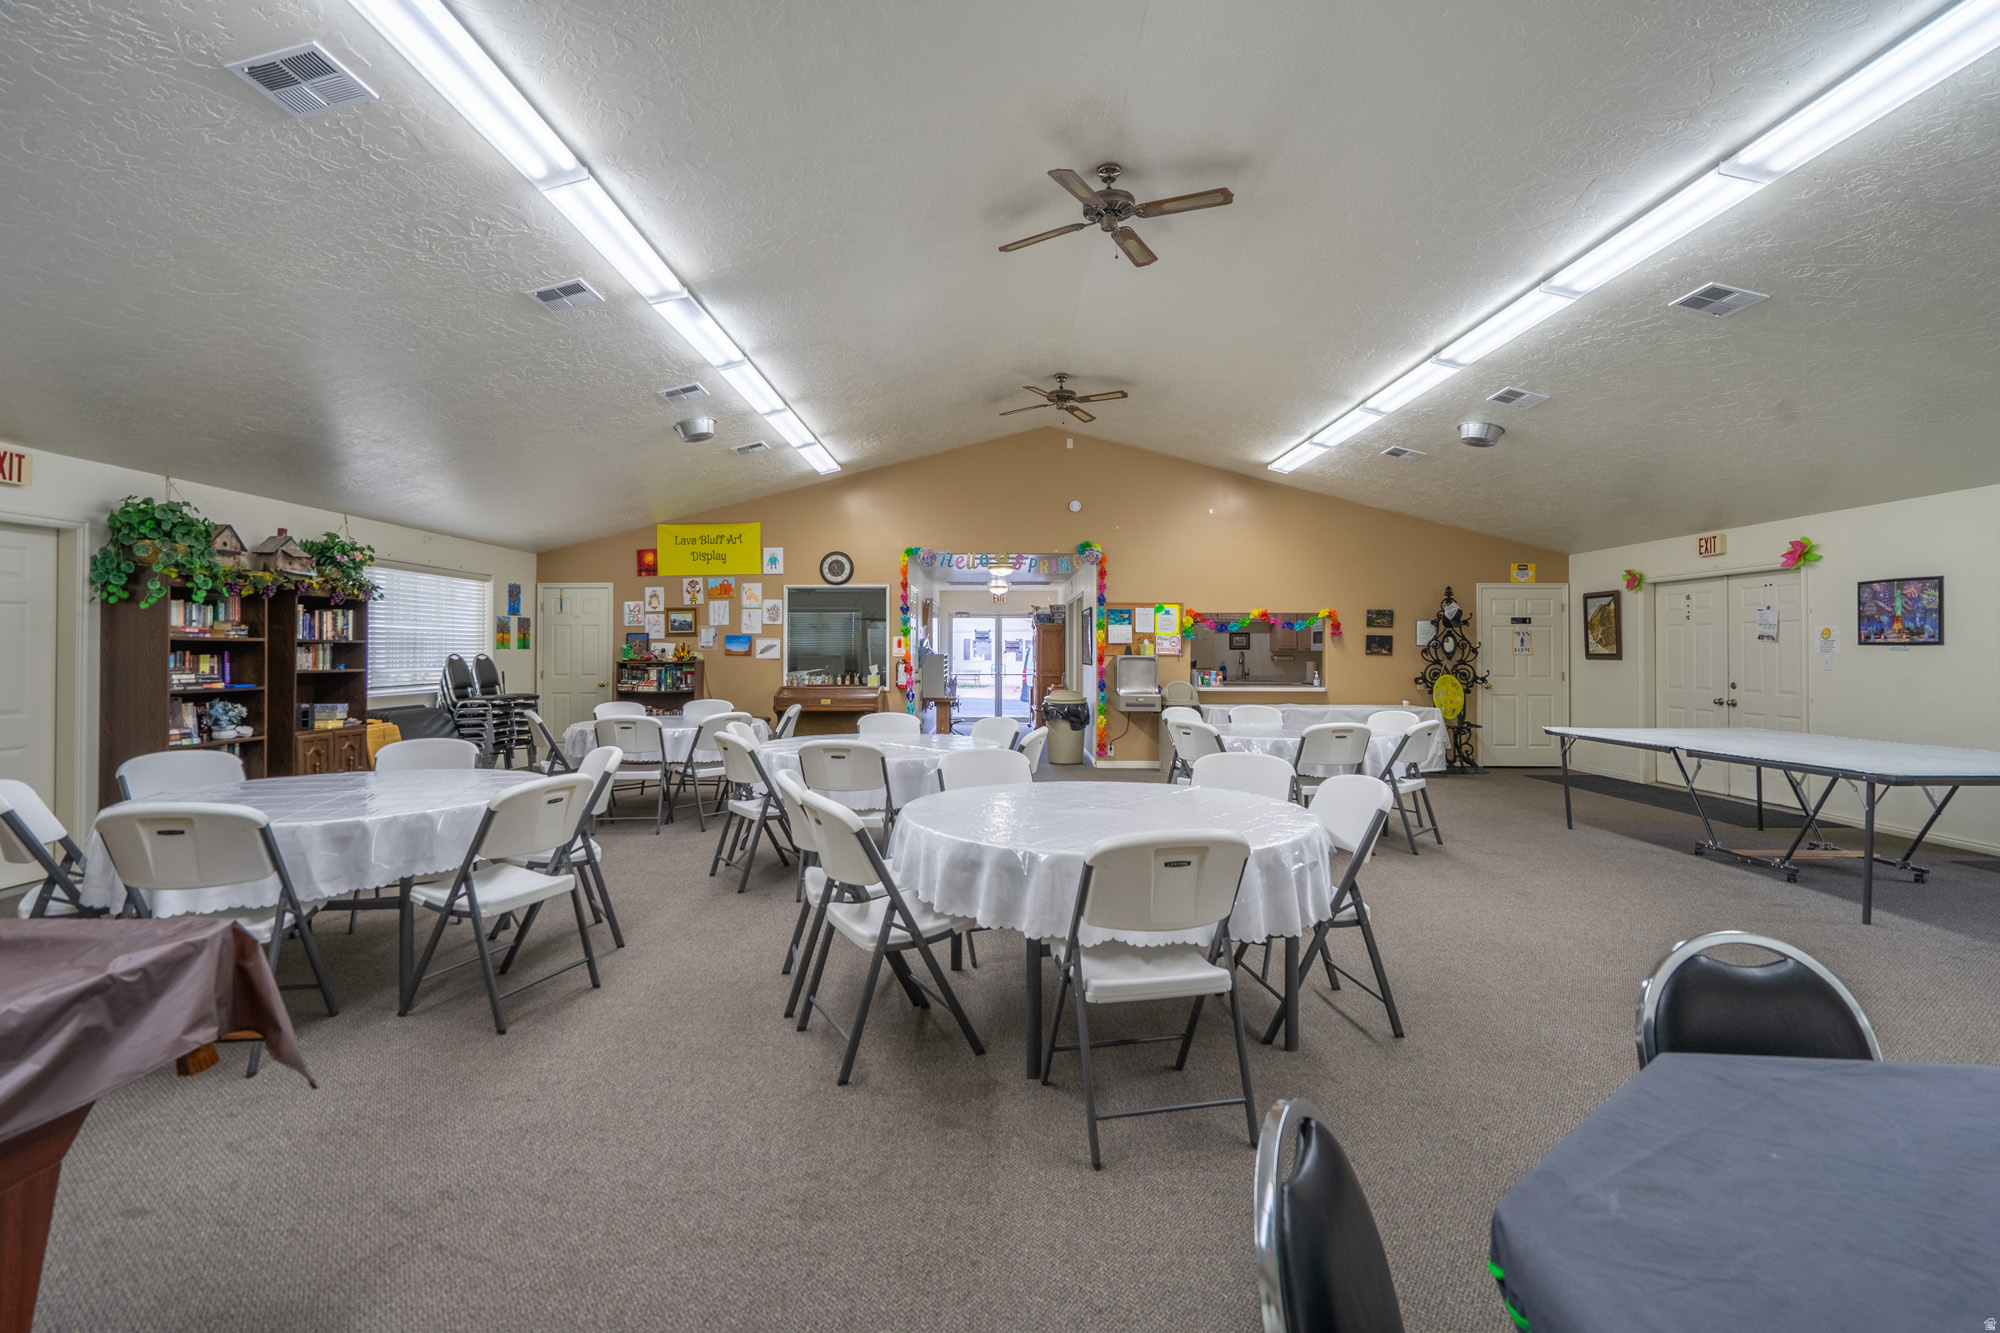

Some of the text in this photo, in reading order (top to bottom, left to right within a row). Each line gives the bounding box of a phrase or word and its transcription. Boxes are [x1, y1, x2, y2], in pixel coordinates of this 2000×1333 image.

[0, 450, 26, 483] XIT
[674, 533, 743, 546] Lava Bluff Art
[1698, 535, 1718, 555] EXIT
[690, 549, 728, 564] Display
[938, 550, 1084, 576] Hello SPRING
[992, 594, 1005, 603] EXIT
